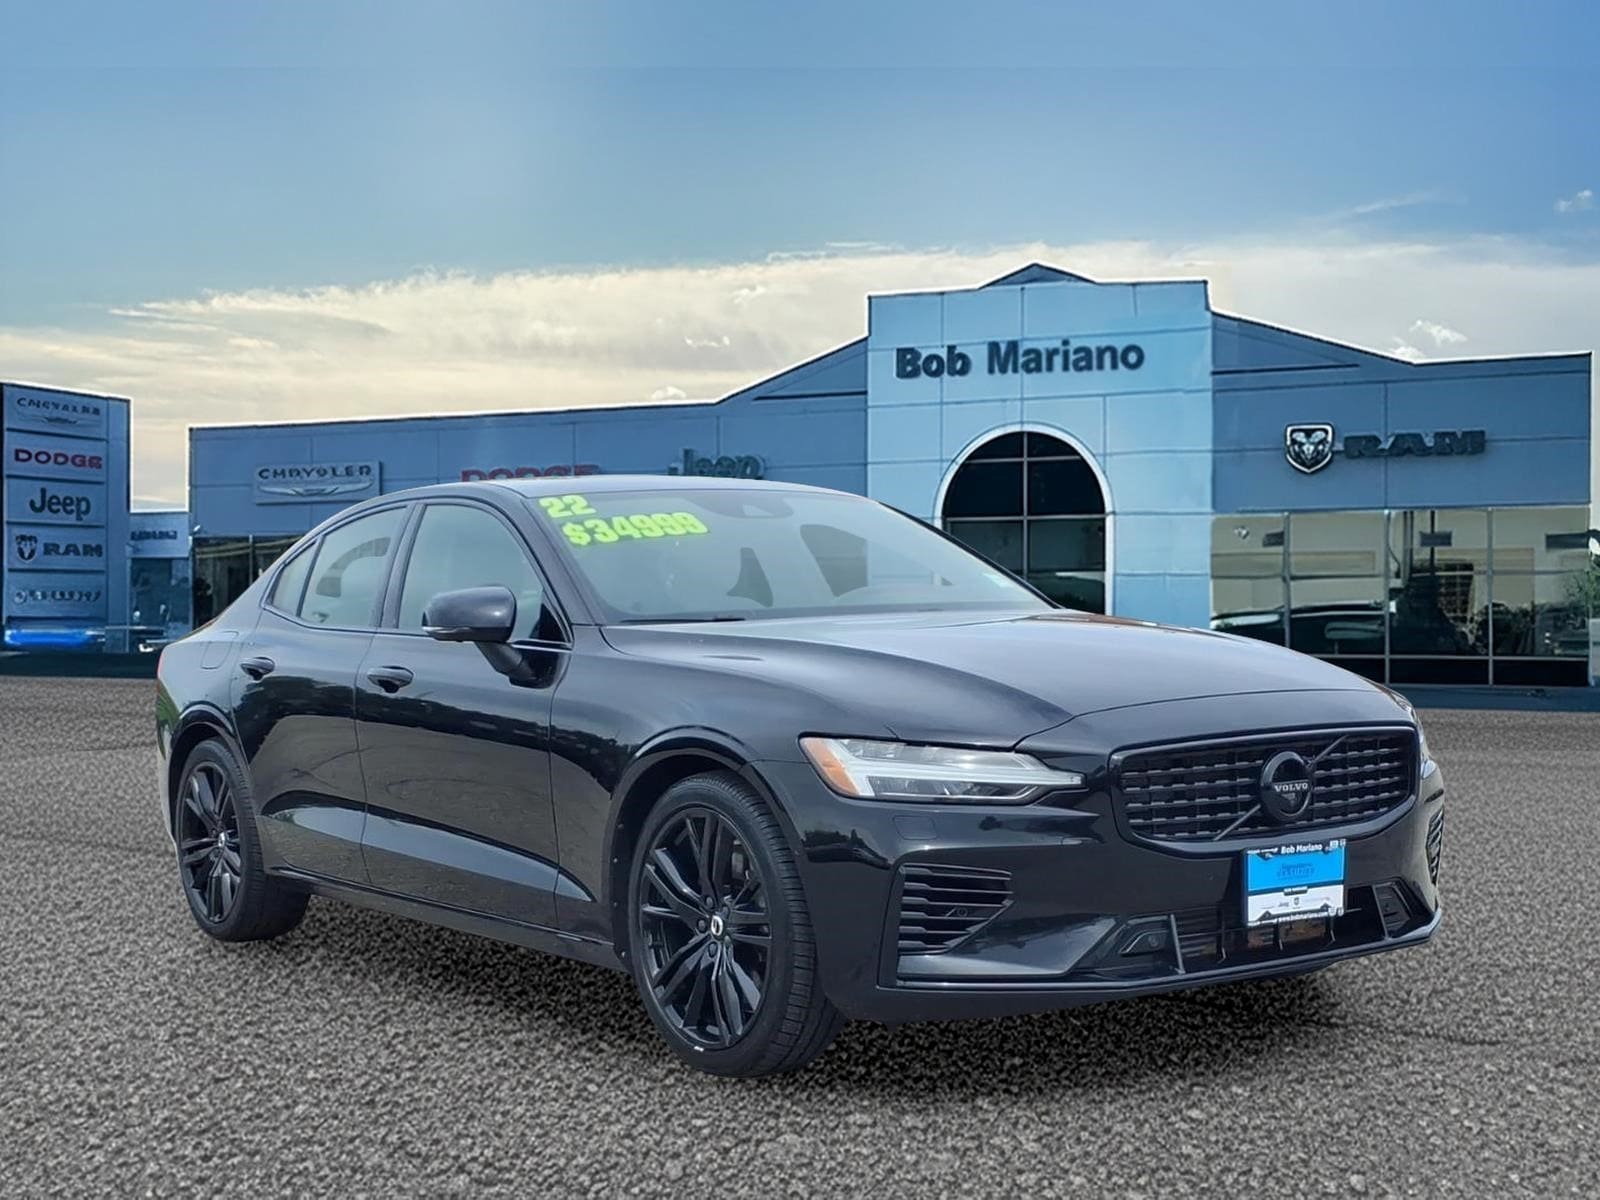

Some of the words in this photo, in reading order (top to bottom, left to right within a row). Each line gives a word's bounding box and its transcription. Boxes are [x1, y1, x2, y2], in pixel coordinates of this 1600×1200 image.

[895, 345, 972, 379] Bob
[986, 338, 1145, 375] Mariano
[1343, 429, 1487, 460] RAM
[14, 448, 103, 470] DODGE
[29, 487, 92, 522] Jeep
[539, 494, 597, 519] 22
[562, 511, 708, 546] $34999
[42, 542, 103, 558] RAM
[1274, 782, 1309, 793] VOLVO
[1281, 845, 1296, 855] Bob
[1296, 843, 1323, 853] Mariano
